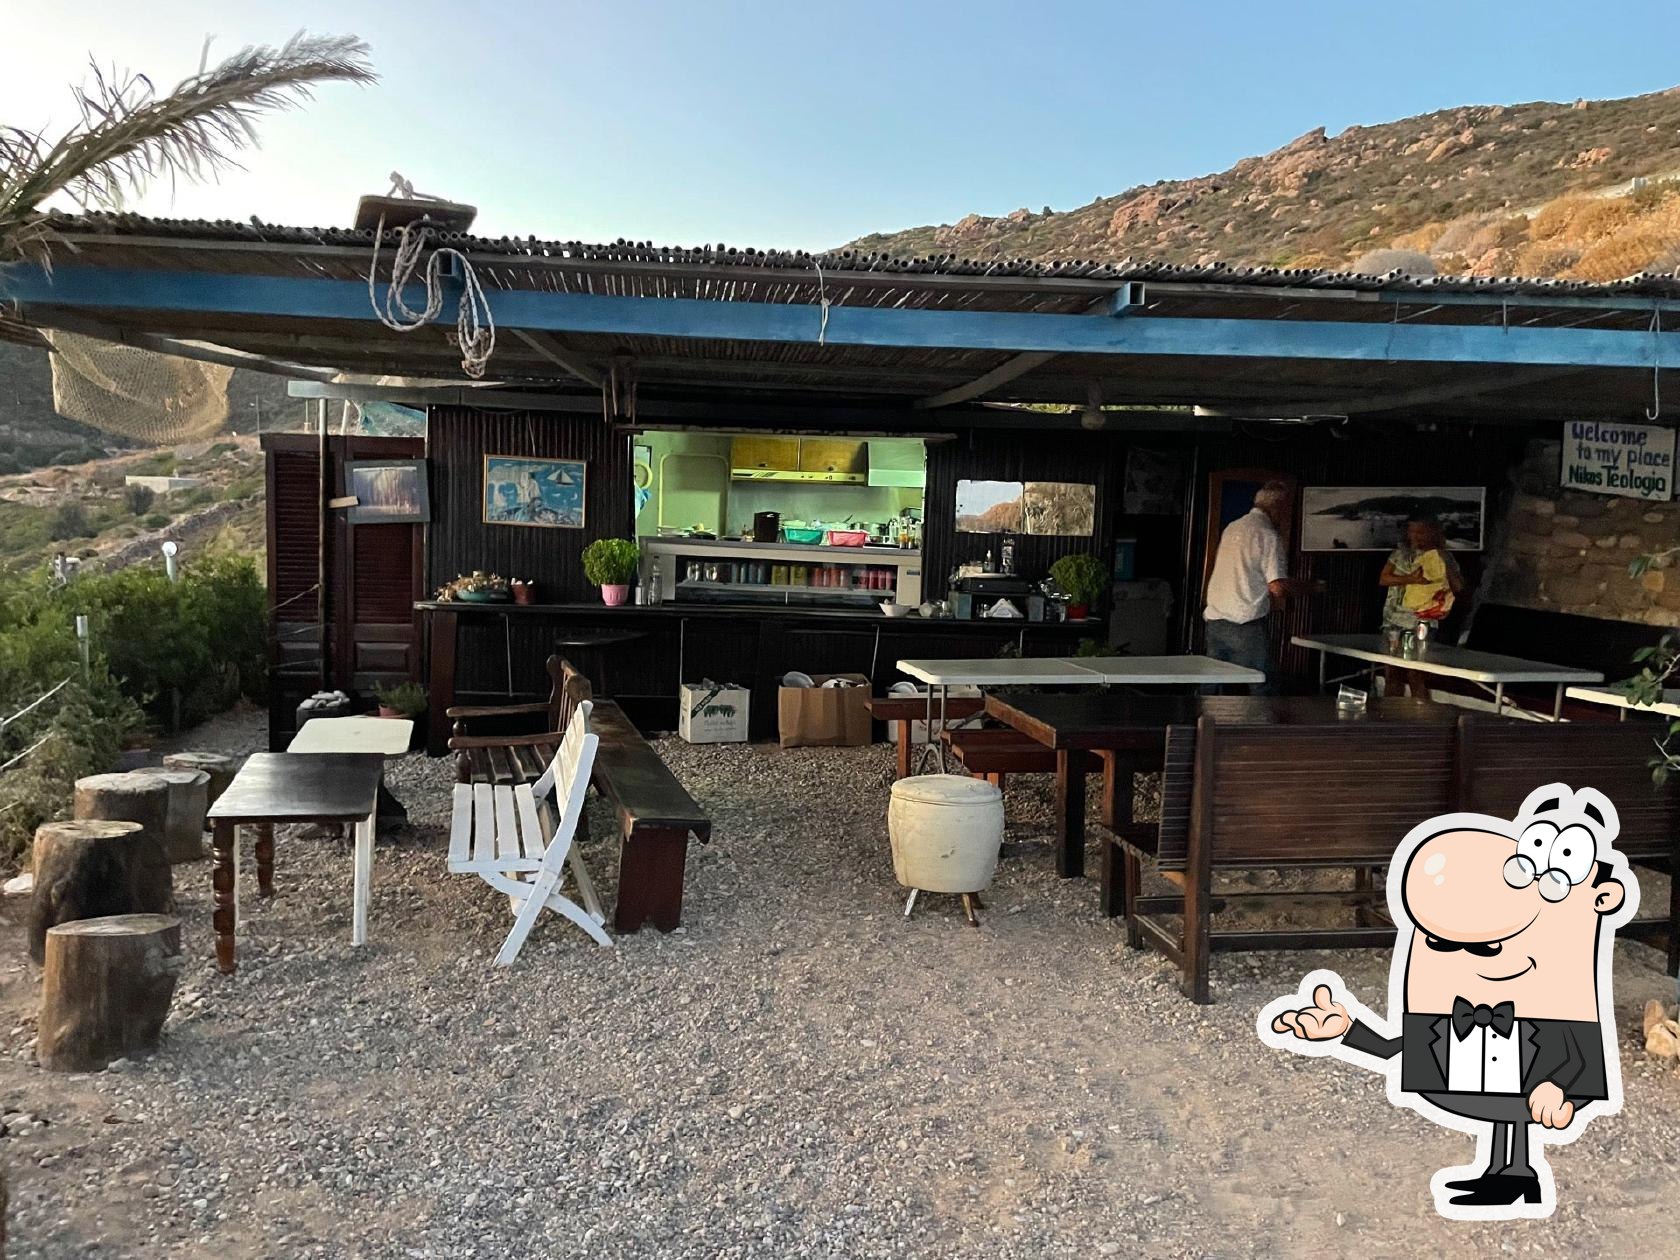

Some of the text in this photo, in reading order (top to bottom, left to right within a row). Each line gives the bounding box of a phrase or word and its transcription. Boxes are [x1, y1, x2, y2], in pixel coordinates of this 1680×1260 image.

[1572, 422, 1647, 446] Welcome
[1576, 441, 1670, 470] to my place
[1569, 464, 1666, 497] Nikos Teologia
